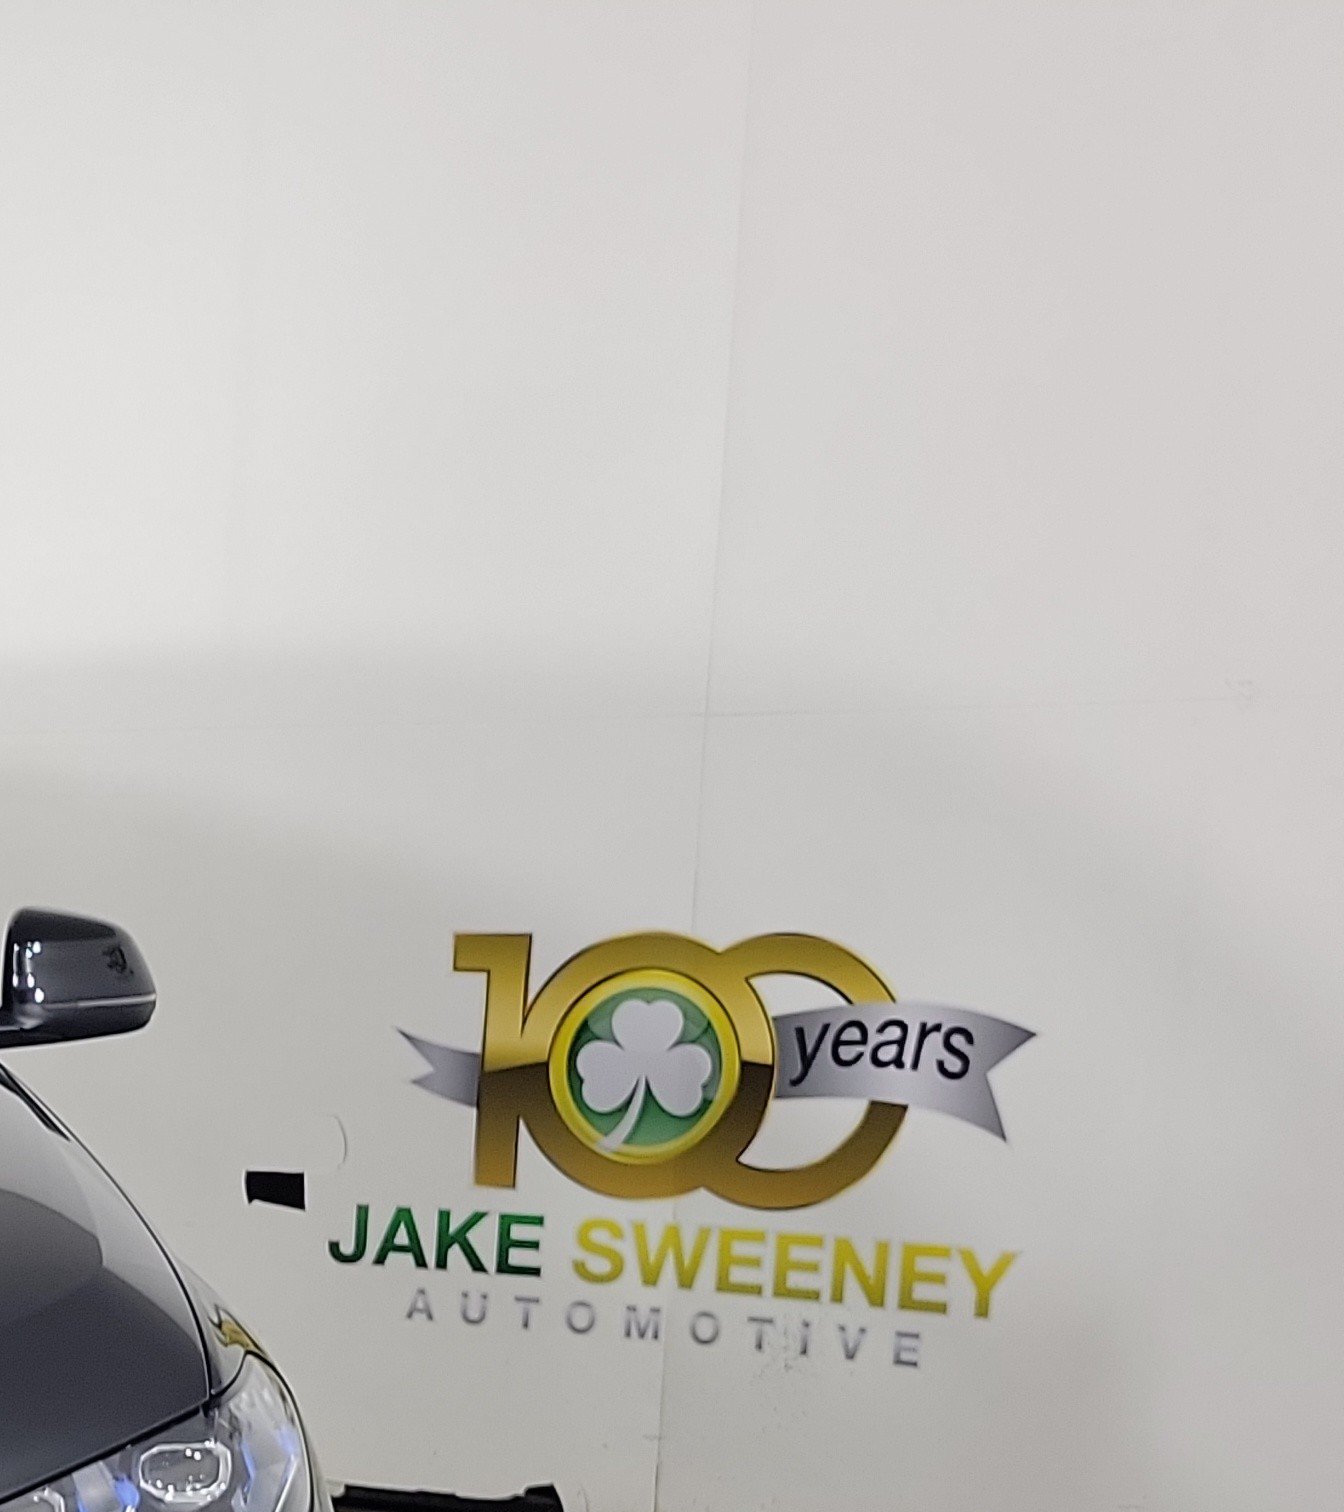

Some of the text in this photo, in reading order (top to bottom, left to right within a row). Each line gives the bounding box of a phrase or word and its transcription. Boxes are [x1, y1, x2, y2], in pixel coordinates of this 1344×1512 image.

[453, 931, 975, 1210] 100 years
[328, 1204, 1018, 1319] JAKE SWEENEY
[406, 1288, 921, 1369] AUTOMOTIVE
